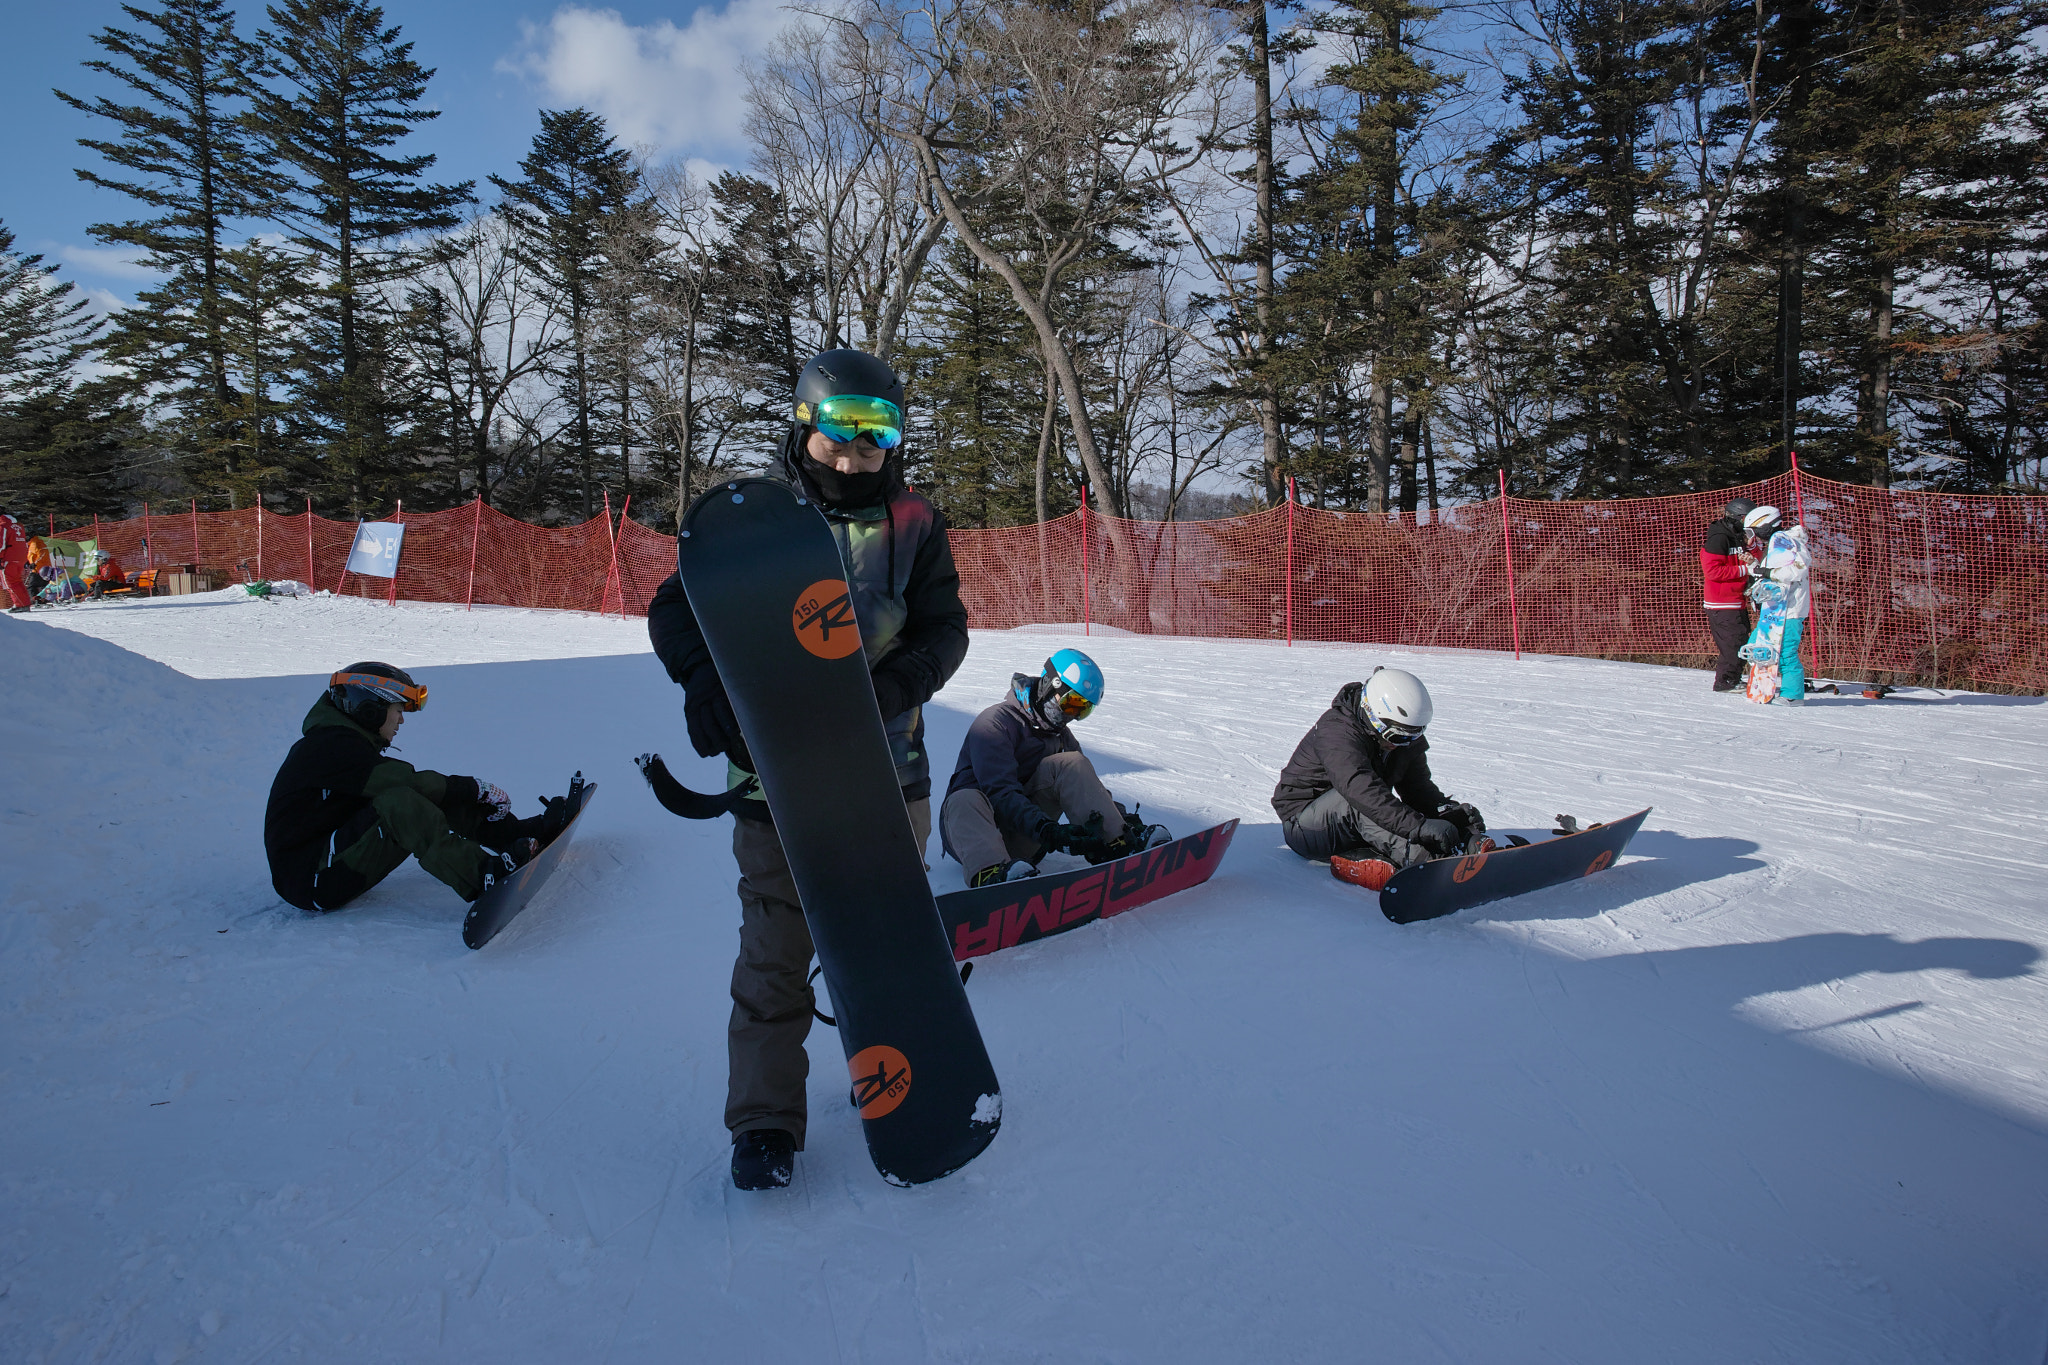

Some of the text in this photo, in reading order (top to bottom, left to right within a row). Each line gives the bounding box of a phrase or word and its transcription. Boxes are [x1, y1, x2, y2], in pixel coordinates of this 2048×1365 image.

[795, 598, 819, 620] 150
[347, 674, 406, 693] POLISI
[887, 1077, 910, 1098] 150
